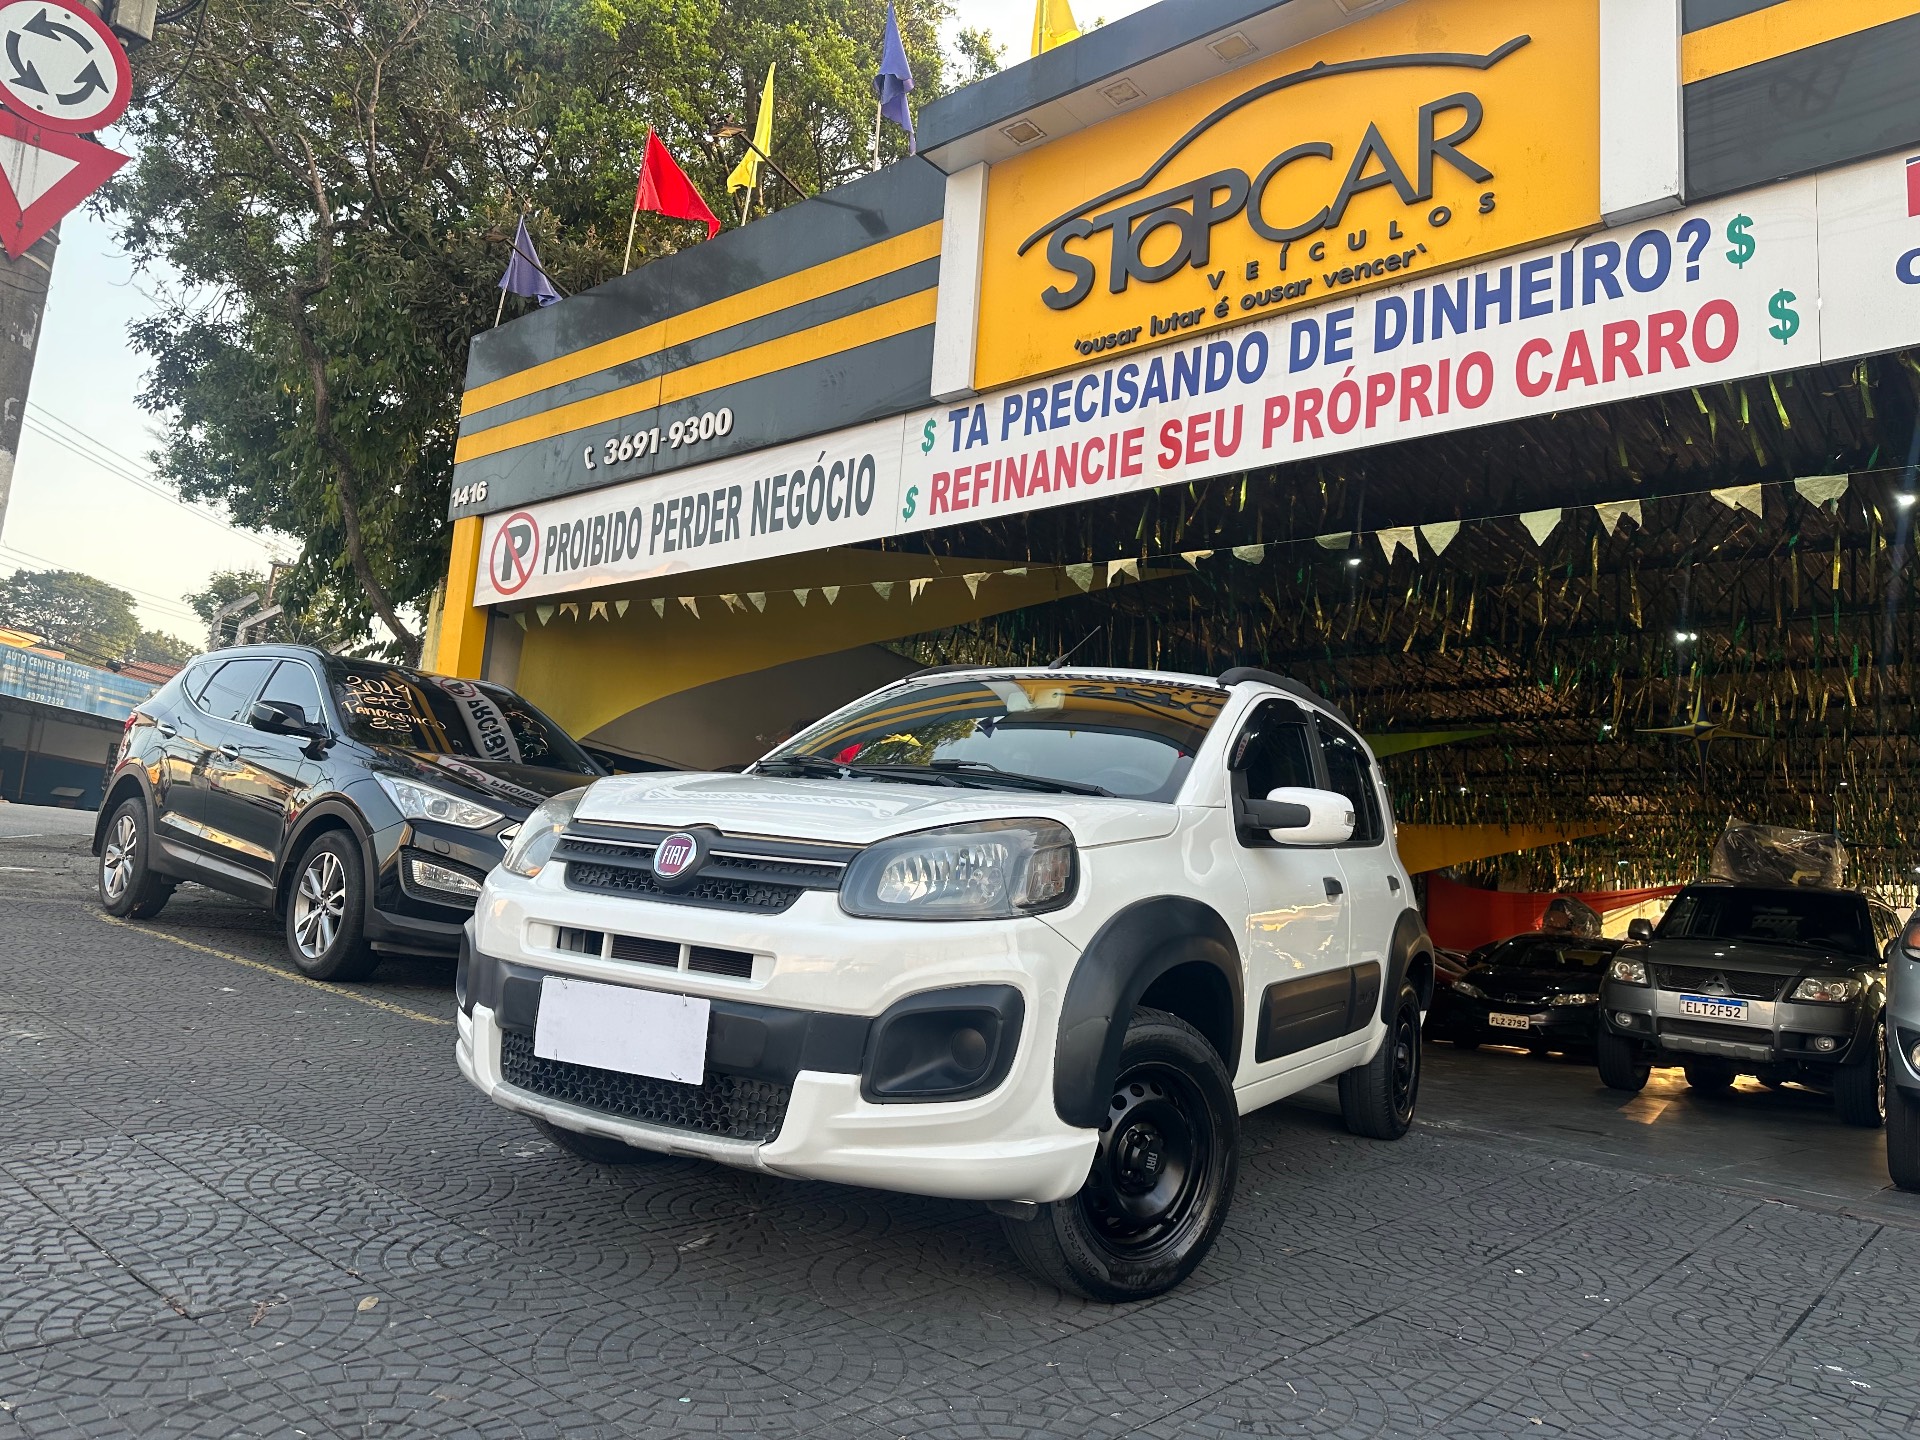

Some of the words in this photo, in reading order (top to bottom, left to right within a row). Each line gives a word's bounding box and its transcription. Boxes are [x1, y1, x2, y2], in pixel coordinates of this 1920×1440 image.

[1149, 306, 1205, 338] lutar
[1214, 296, 1229, 319] é
[1240, 278, 1313, 311] ousar
[947, 397, 990, 454] TA
[1000, 330, 1270, 442] PRECISANDO
[1289, 306, 1355, 374] DE
[1373, 217, 1712, 355] DINHEIRO?
[928, 427, 1145, 517] REFINANCIE
[1156, 403, 1244, 471] SEU
[1262, 350, 1495, 444] PRÓPRIO
[1515, 298, 1740, 398] CARRO
[602, 406, 735, 468] 3691-9300
[450, 479, 489, 508] 1416
[542, 505, 643, 576] PROIBIDO
[648, 483, 742, 557] PERDER
[750, 450, 877, 537] NEGÓCIO
[5, 650, 28, 664] AUTO
[29, 656, 56, 671] CENTER
[661, 845, 690, 866] FIAT
[1686, 1001, 1741, 1019] ELT2F52
[1145, 1151, 1159, 1172] FIAT
